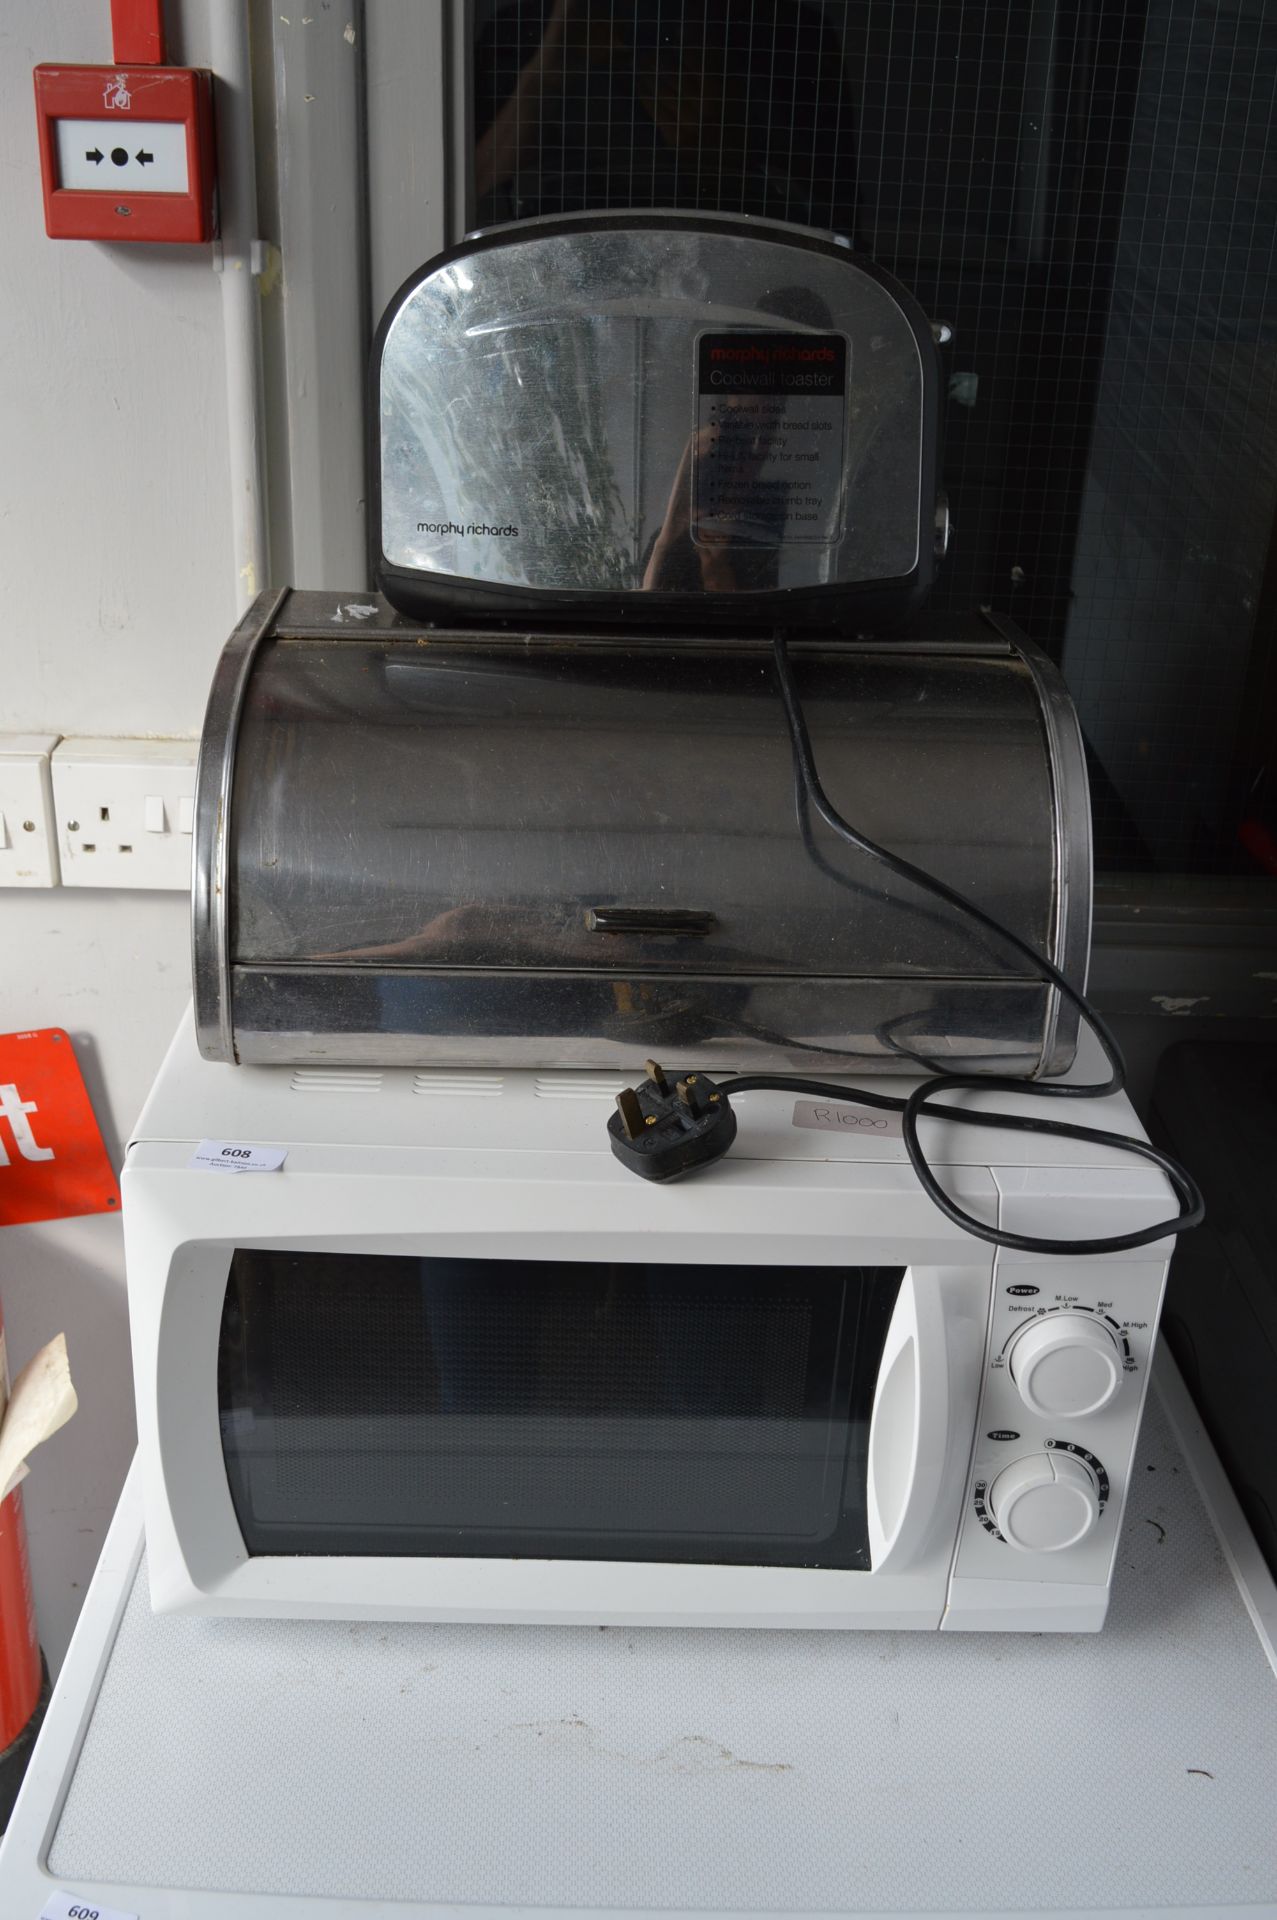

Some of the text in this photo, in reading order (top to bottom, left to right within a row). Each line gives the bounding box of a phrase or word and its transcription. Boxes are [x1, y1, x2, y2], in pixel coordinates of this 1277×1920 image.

[710, 345, 835, 364] morphy richards
[710, 370, 834, 386] Coolwall toaster
[783, 421, 809, 431] bread
[811, 421, 832, 431] slots
[780, 452, 793, 461] for
[794, 452, 820, 462] small
[805, 497, 823, 507] tray
[795, 511, 818, 521] base
[417, 521, 519, 537] morphy richards
[221, 1147, 252, 1159] 608
[1008, 1286, 1039, 1295] Power
[1054, 1294, 1079, 1302] M.Low
[1008, 1305, 1035, 1313] Defrost
[1122, 1321, 1148, 1330] M.High
[992, 1432, 1016, 1440] Time
[68, 1904, 99, 1920] 609
